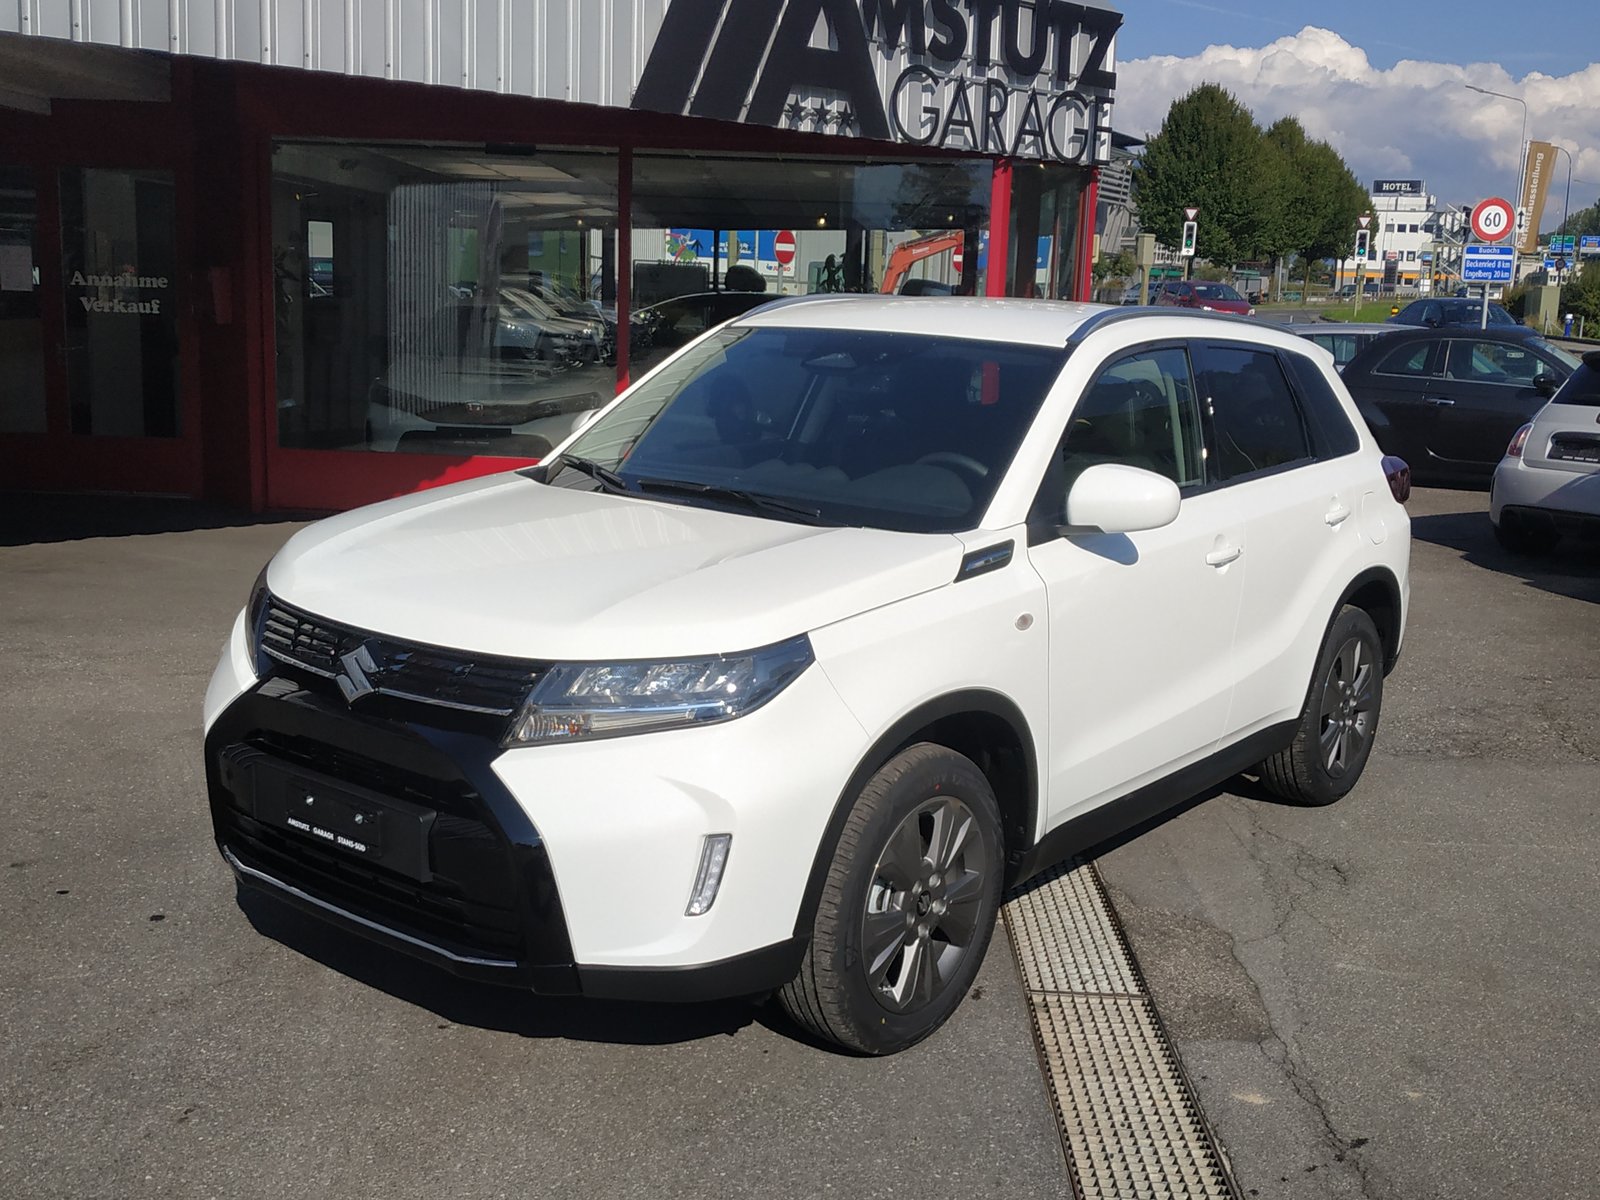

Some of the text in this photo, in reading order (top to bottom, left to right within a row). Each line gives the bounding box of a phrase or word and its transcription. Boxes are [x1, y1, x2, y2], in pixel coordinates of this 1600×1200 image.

[746, 0, 1124, 140] AMSTUTZ
[889, 64, 1115, 166] GARAGE
[1382, 182, 1412, 191] HOTEL
[1484, 211, 1501, 227] 60
[1478, 246, 1500, 254] Buochs
[1466, 259, 1511, 268] Beckenried 8 km
[70, 270, 169, 289] Annahme
[1465, 269, 1510, 279] Engelberg 20 km
[79, 295, 161, 314] Verkauf
[312, 826, 334, 840] GARAGE
